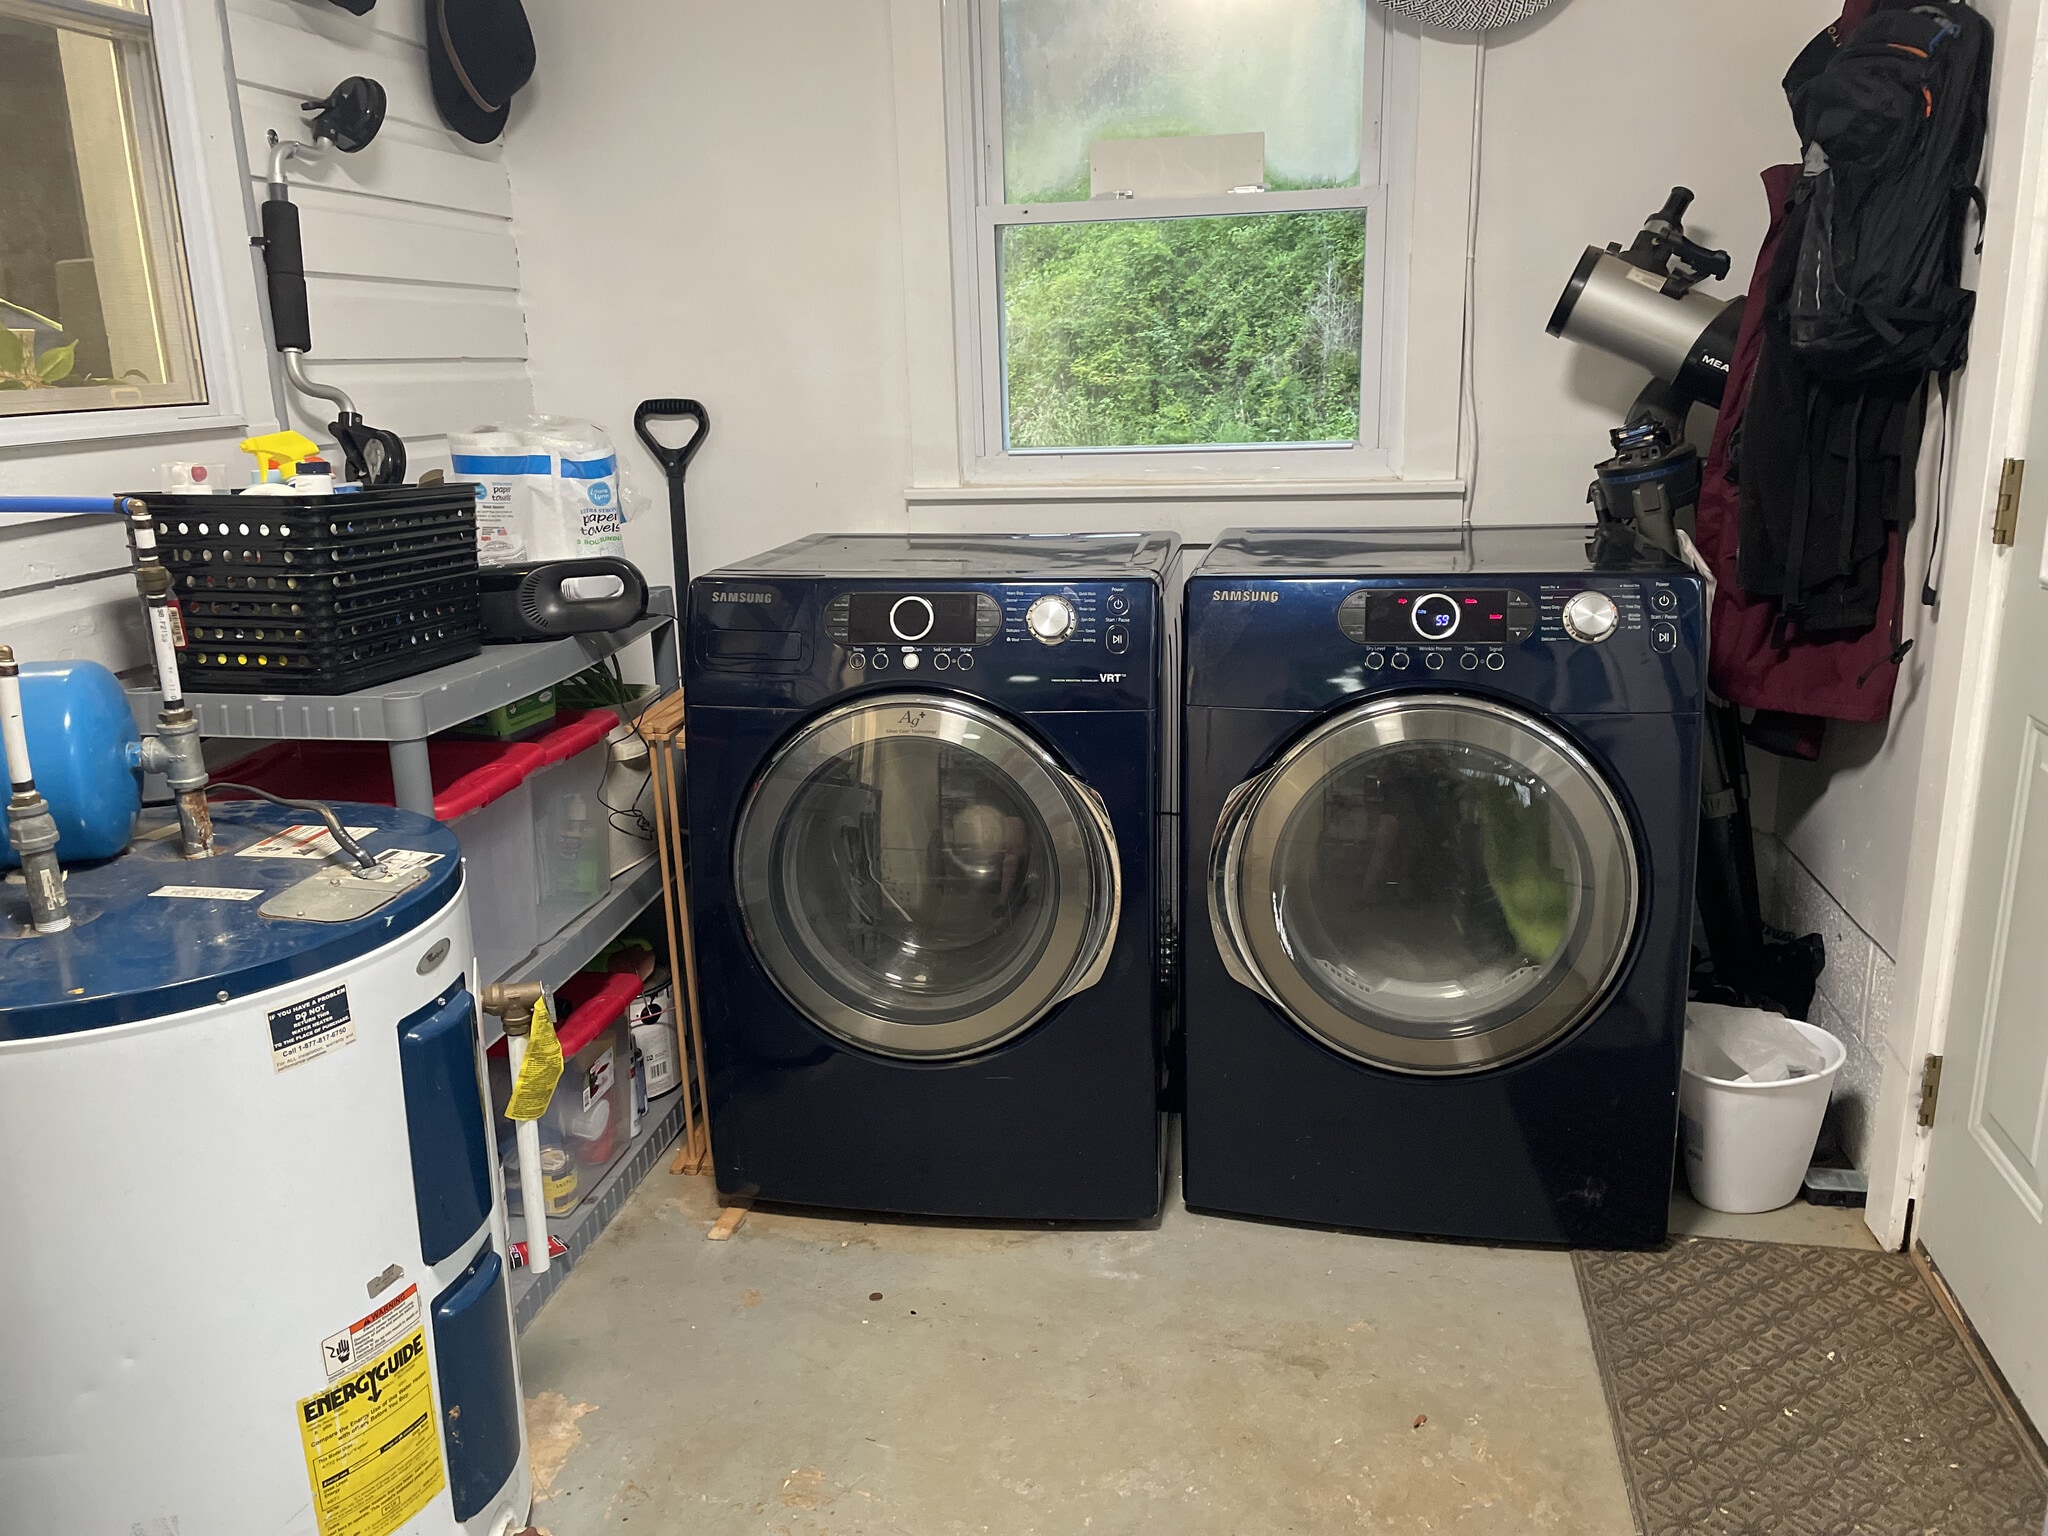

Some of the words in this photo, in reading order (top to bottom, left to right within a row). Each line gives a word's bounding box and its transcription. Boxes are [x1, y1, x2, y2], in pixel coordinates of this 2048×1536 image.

[1702, 355, 1730, 372] MEA
[712, 591, 772, 604] SAMSUNG
[1213, 590, 1279, 602] SAMSUNG
[1436, 615, 1449, 626] 59
[277, 1009, 291, 1017] YOU
[292, 1002, 310, 1011] HAVE
[317, 988, 345, 1002] PROBLEM
[294, 1012, 307, 1020] DO
[308, 1004, 326, 1014] NOT
[291, 1025, 311, 1035] WATER
[312, 1016, 333, 1026] HEATER
[292, 1016, 316, 1027] RETURN
[295, 1031, 313, 1040] PLACE
[282, 1048, 296, 1057] Call
[372, 1292, 406, 1320] WARNING
[304, 1333, 423, 1423] ENERGYGUIDE
[311, 1431, 338, 1447] Compare
[350, 1413, 369, 1427] Energy
[370, 1406, 381, 1414] Use
[338, 1432, 350, 1440] with
[370, 1408, 387, 1421] Before
